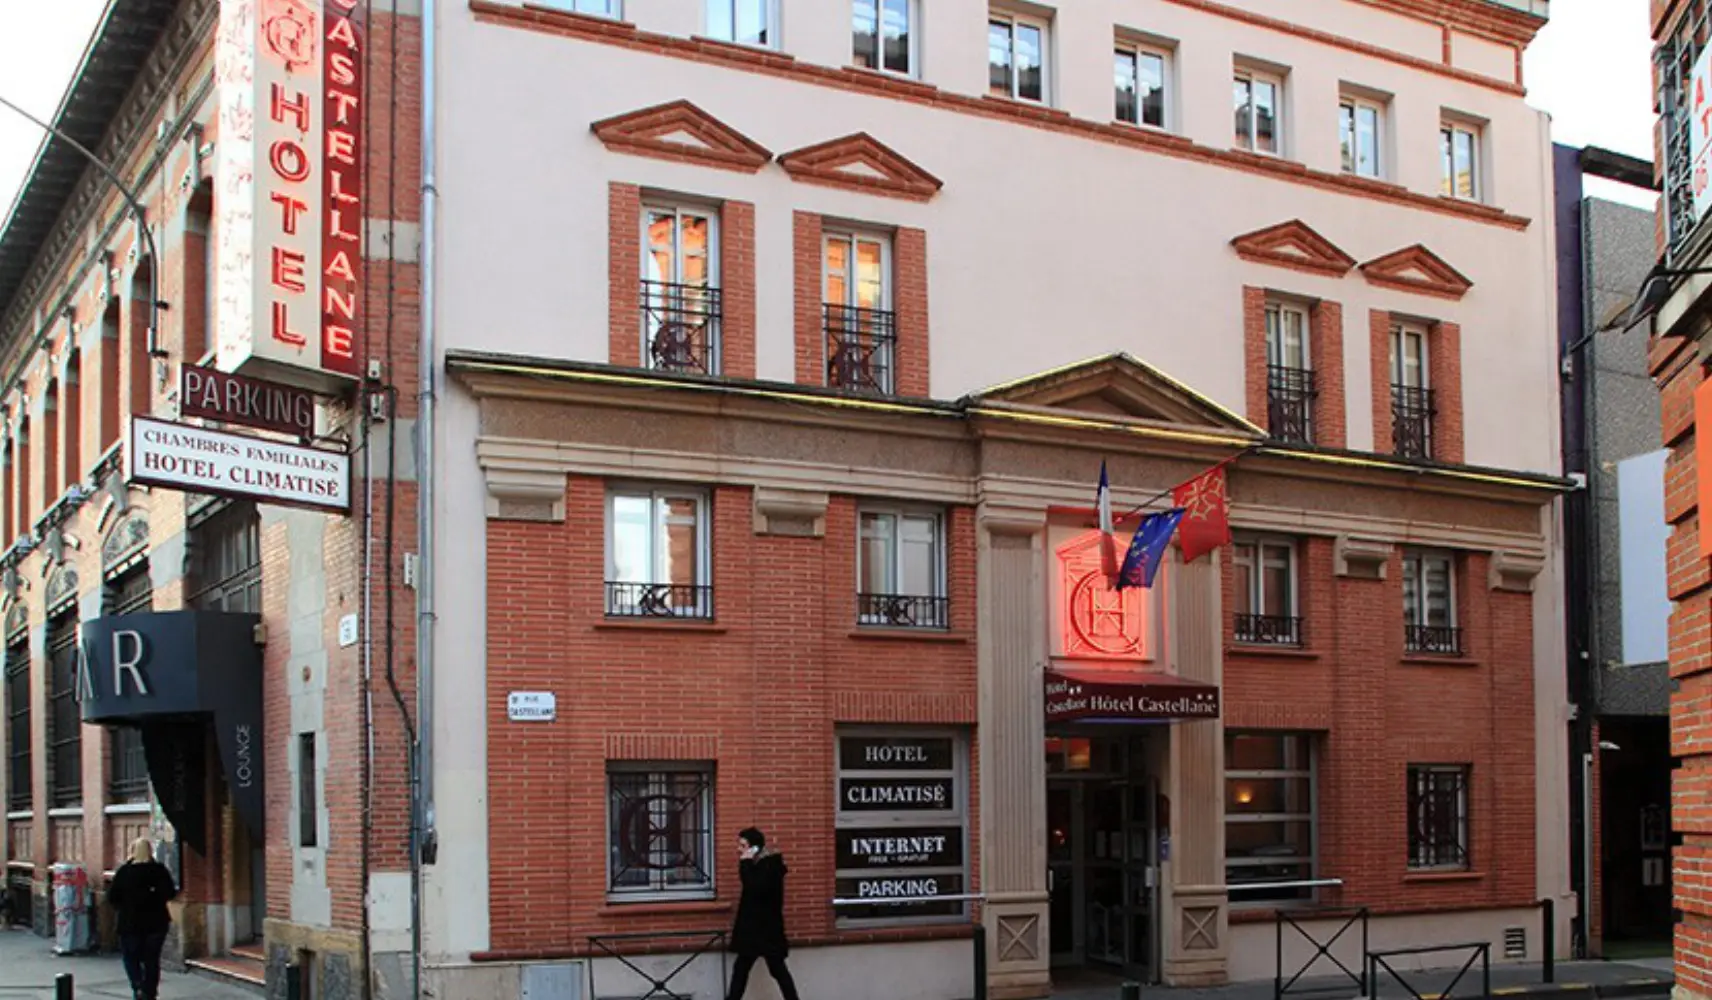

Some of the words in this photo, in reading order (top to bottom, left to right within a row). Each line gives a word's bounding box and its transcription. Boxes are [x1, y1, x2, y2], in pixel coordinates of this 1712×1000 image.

[269, 81, 312, 349] HOTEL
[184, 371, 311, 428] PARKING
[143, 428, 240, 455] CHAMBRES
[246, 446, 339, 473] FAMILIALES
[144, 452, 222, 480] HOTEL
[229, 465, 339, 498] CLIMATISÉ
[1138, 697, 1217, 714] Castellane
[236, 724, 252, 788] LOUNGE
[865, 745, 928, 763] HOTEL
[847, 783, 945, 805] CLIMATISÉ
[851, 836, 946, 855] INTERNET
[859, 878, 938, 897] PARKING
